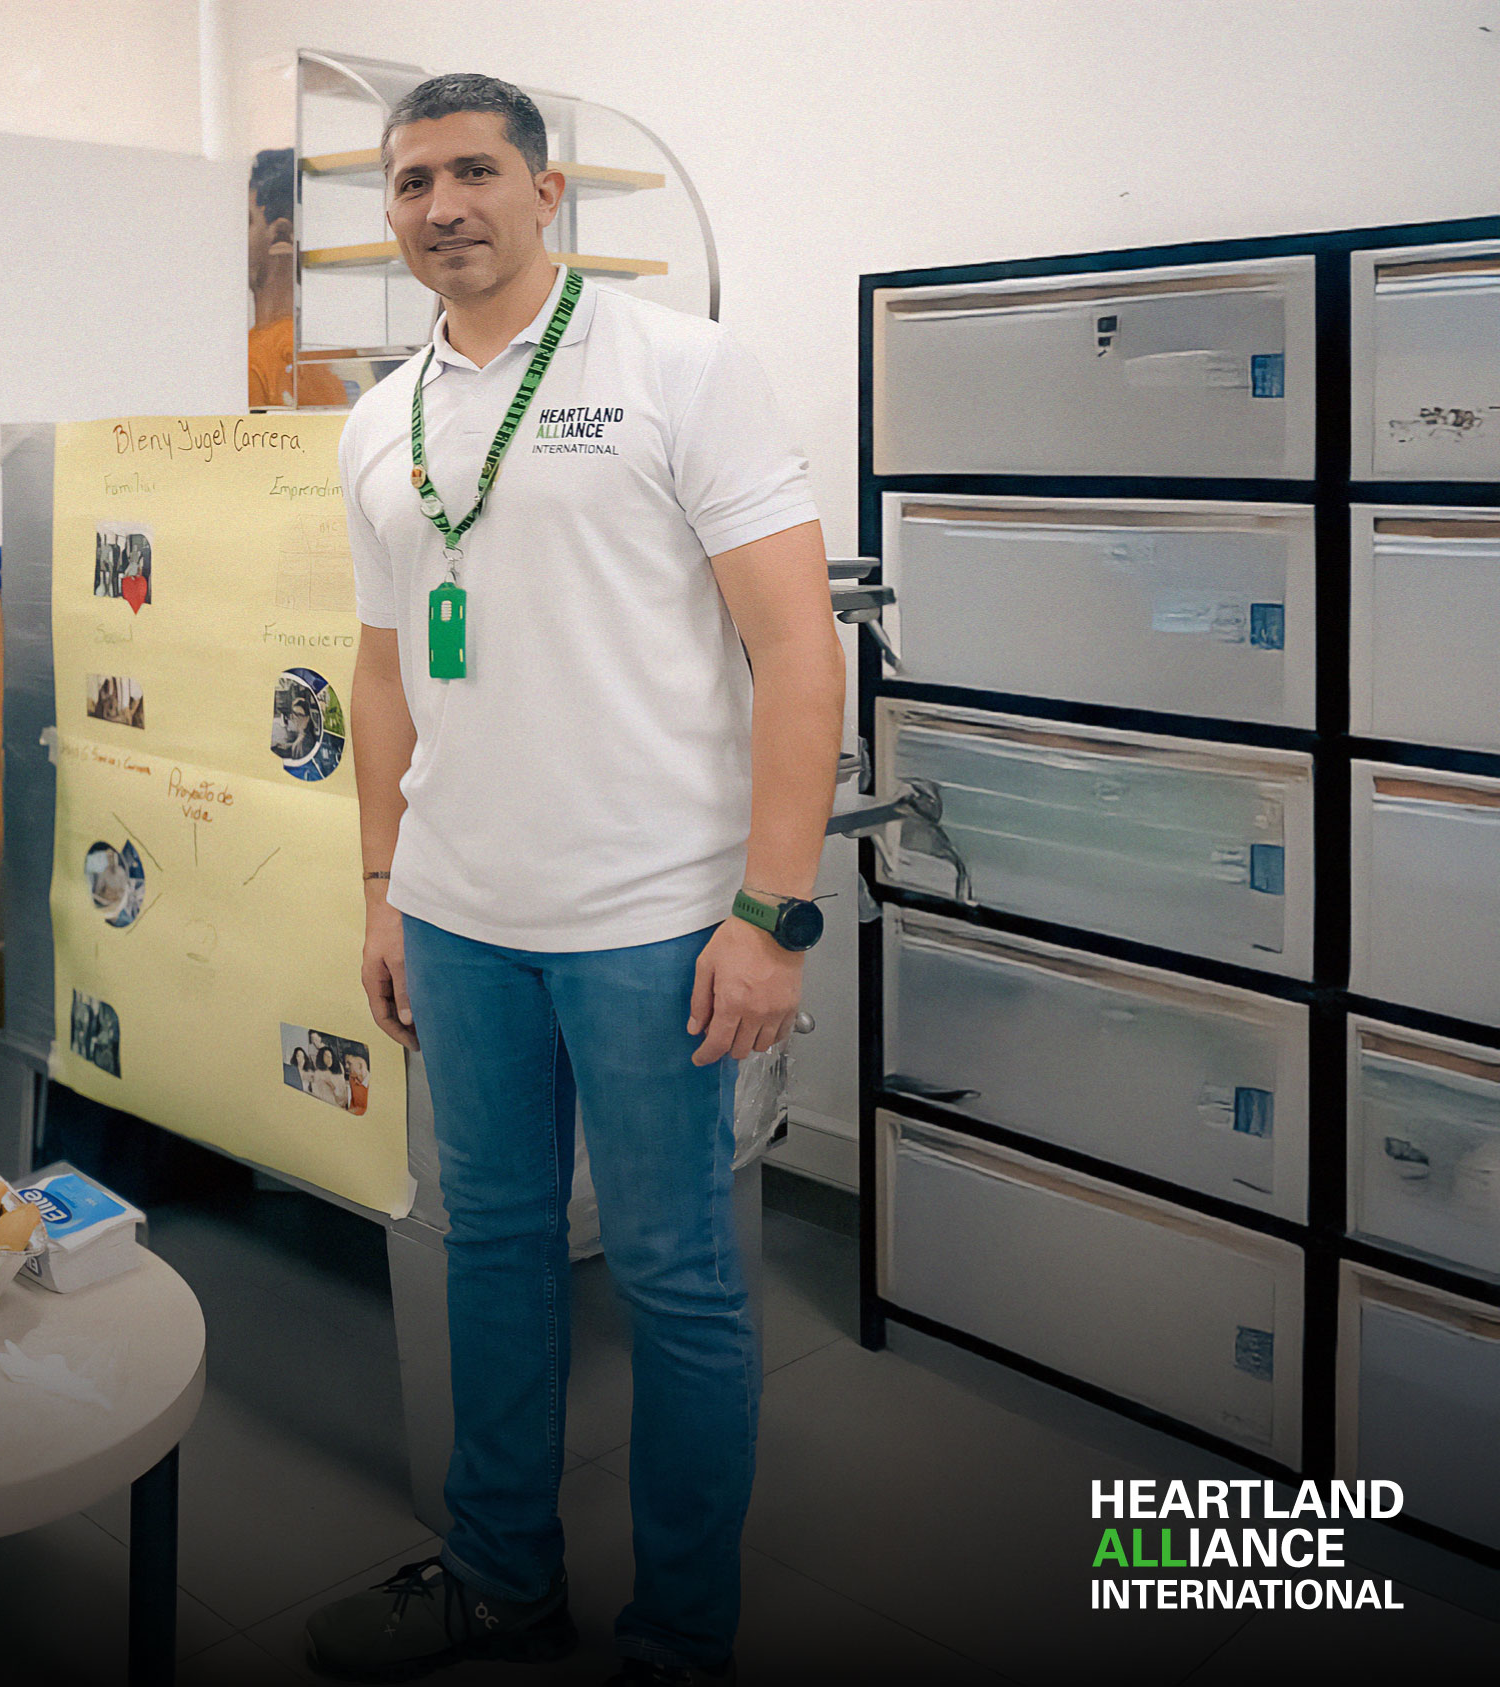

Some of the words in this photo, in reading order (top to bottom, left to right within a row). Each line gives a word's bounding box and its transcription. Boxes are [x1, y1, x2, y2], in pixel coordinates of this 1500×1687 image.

[539, 407, 624, 424] HEARTLAND
[536, 422, 605, 439] ALLIANCE
[112, 420, 173, 460] Bleny
[532, 443, 619, 456] INTERNATIONAL
[263, 622, 354, 648] Financiero
